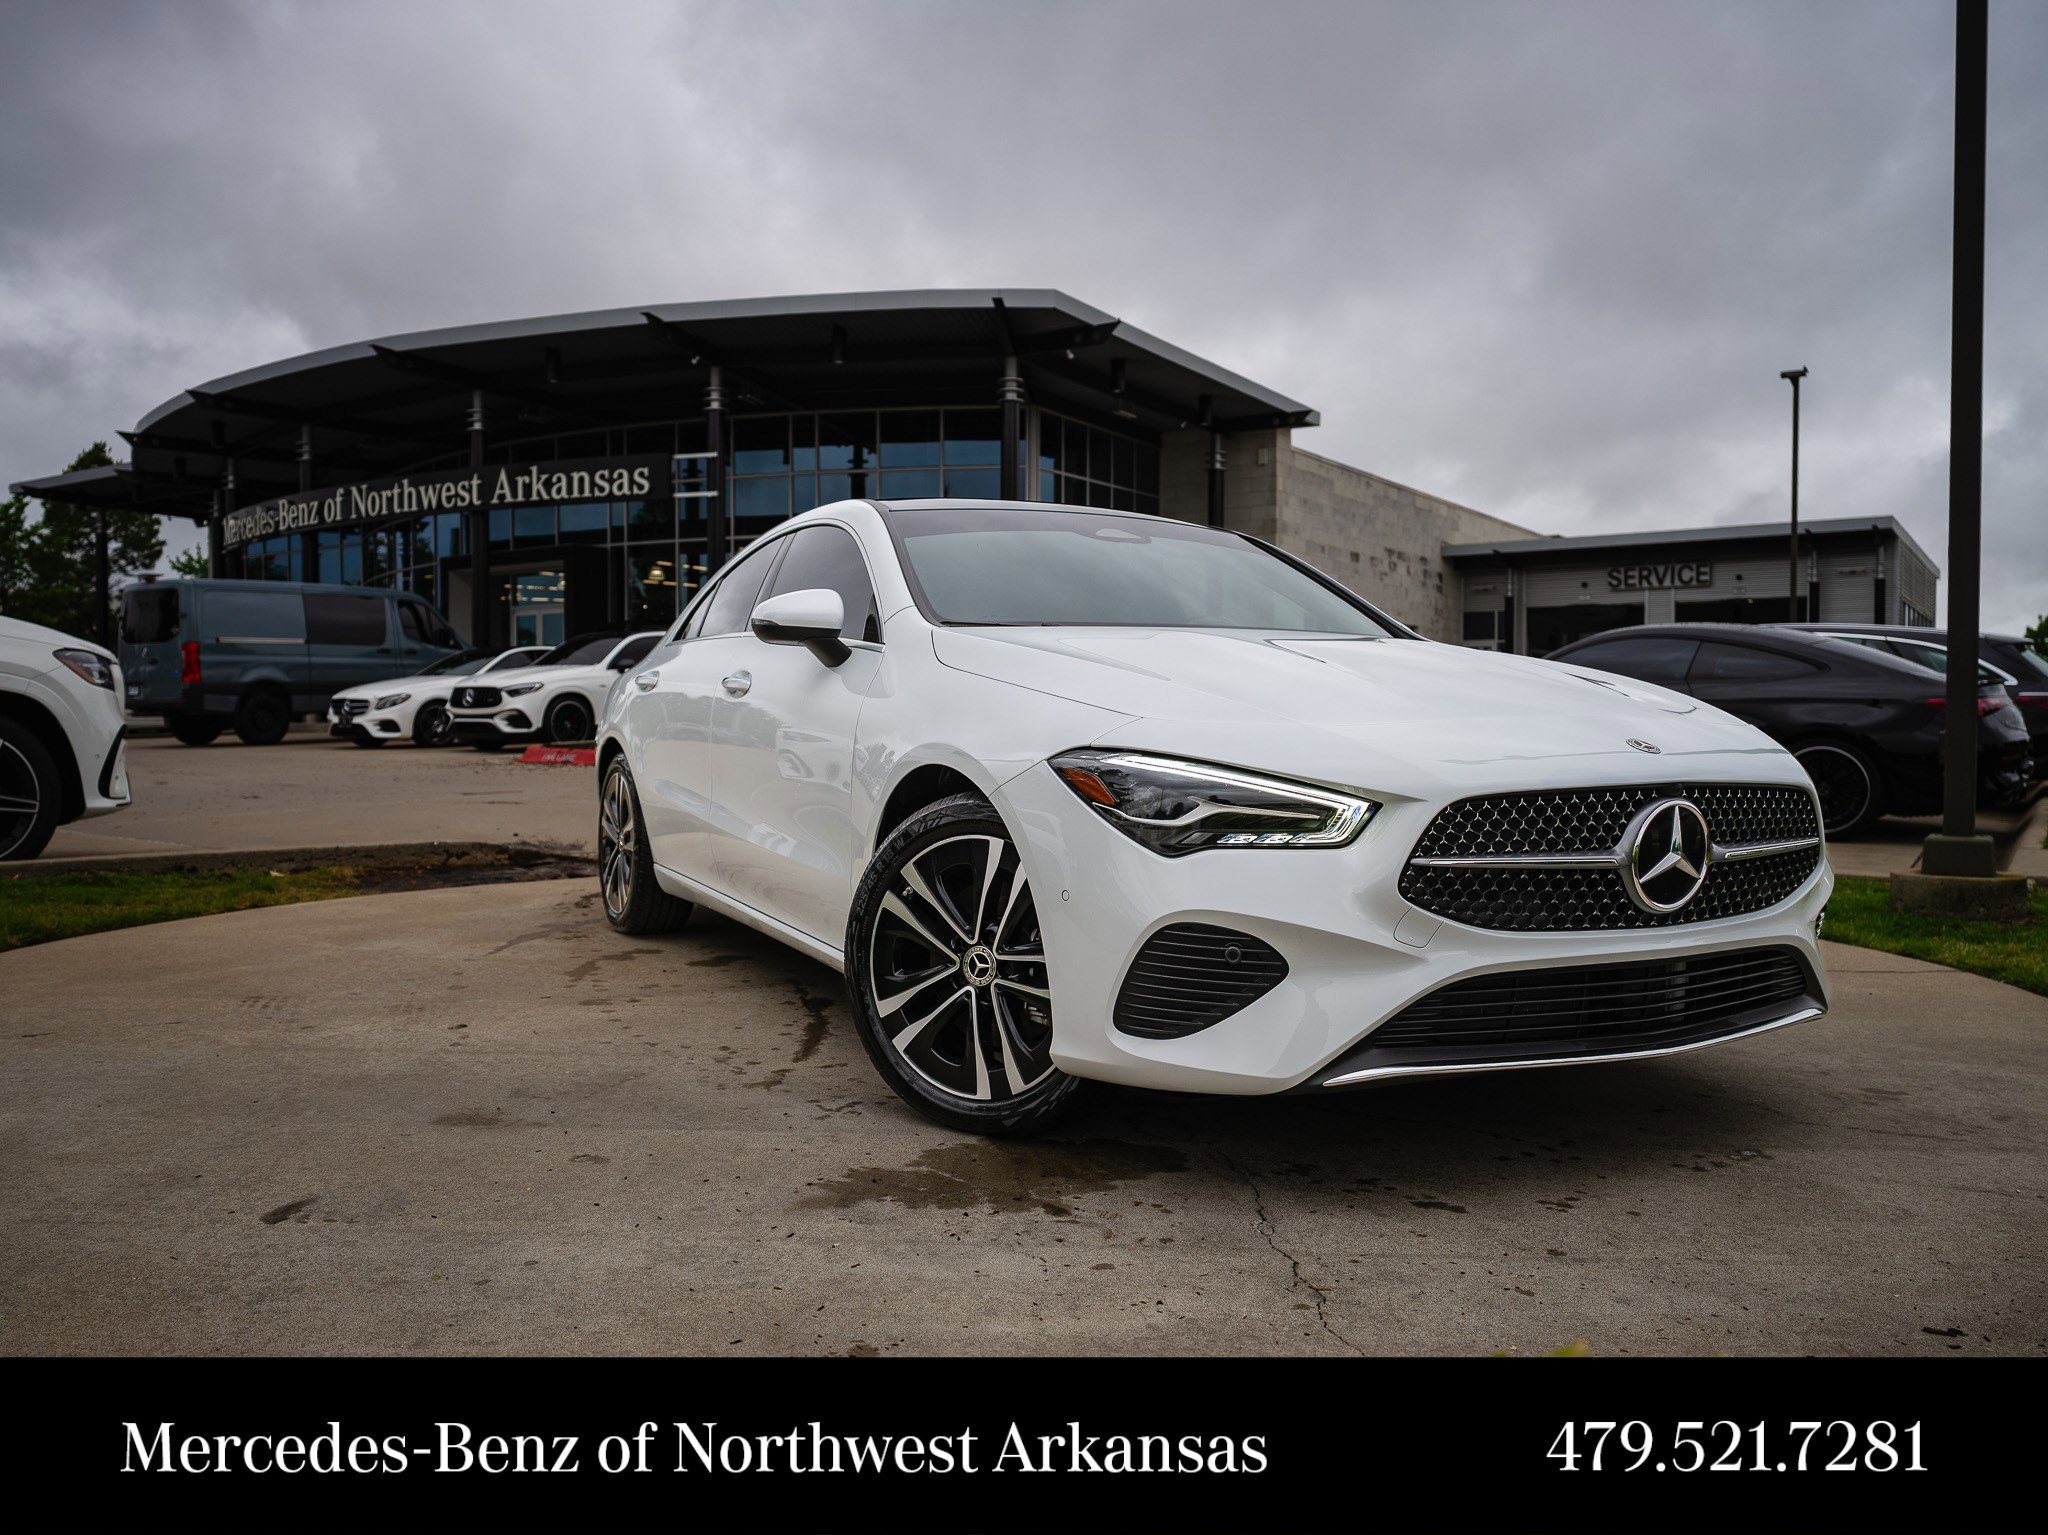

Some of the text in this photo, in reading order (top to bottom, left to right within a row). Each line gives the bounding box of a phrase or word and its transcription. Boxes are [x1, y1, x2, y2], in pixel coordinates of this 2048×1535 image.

[223, 464, 650, 546] Mercedes-Benz of Northwest Arkansas
[1608, 563, 1711, 588] SERVICE
